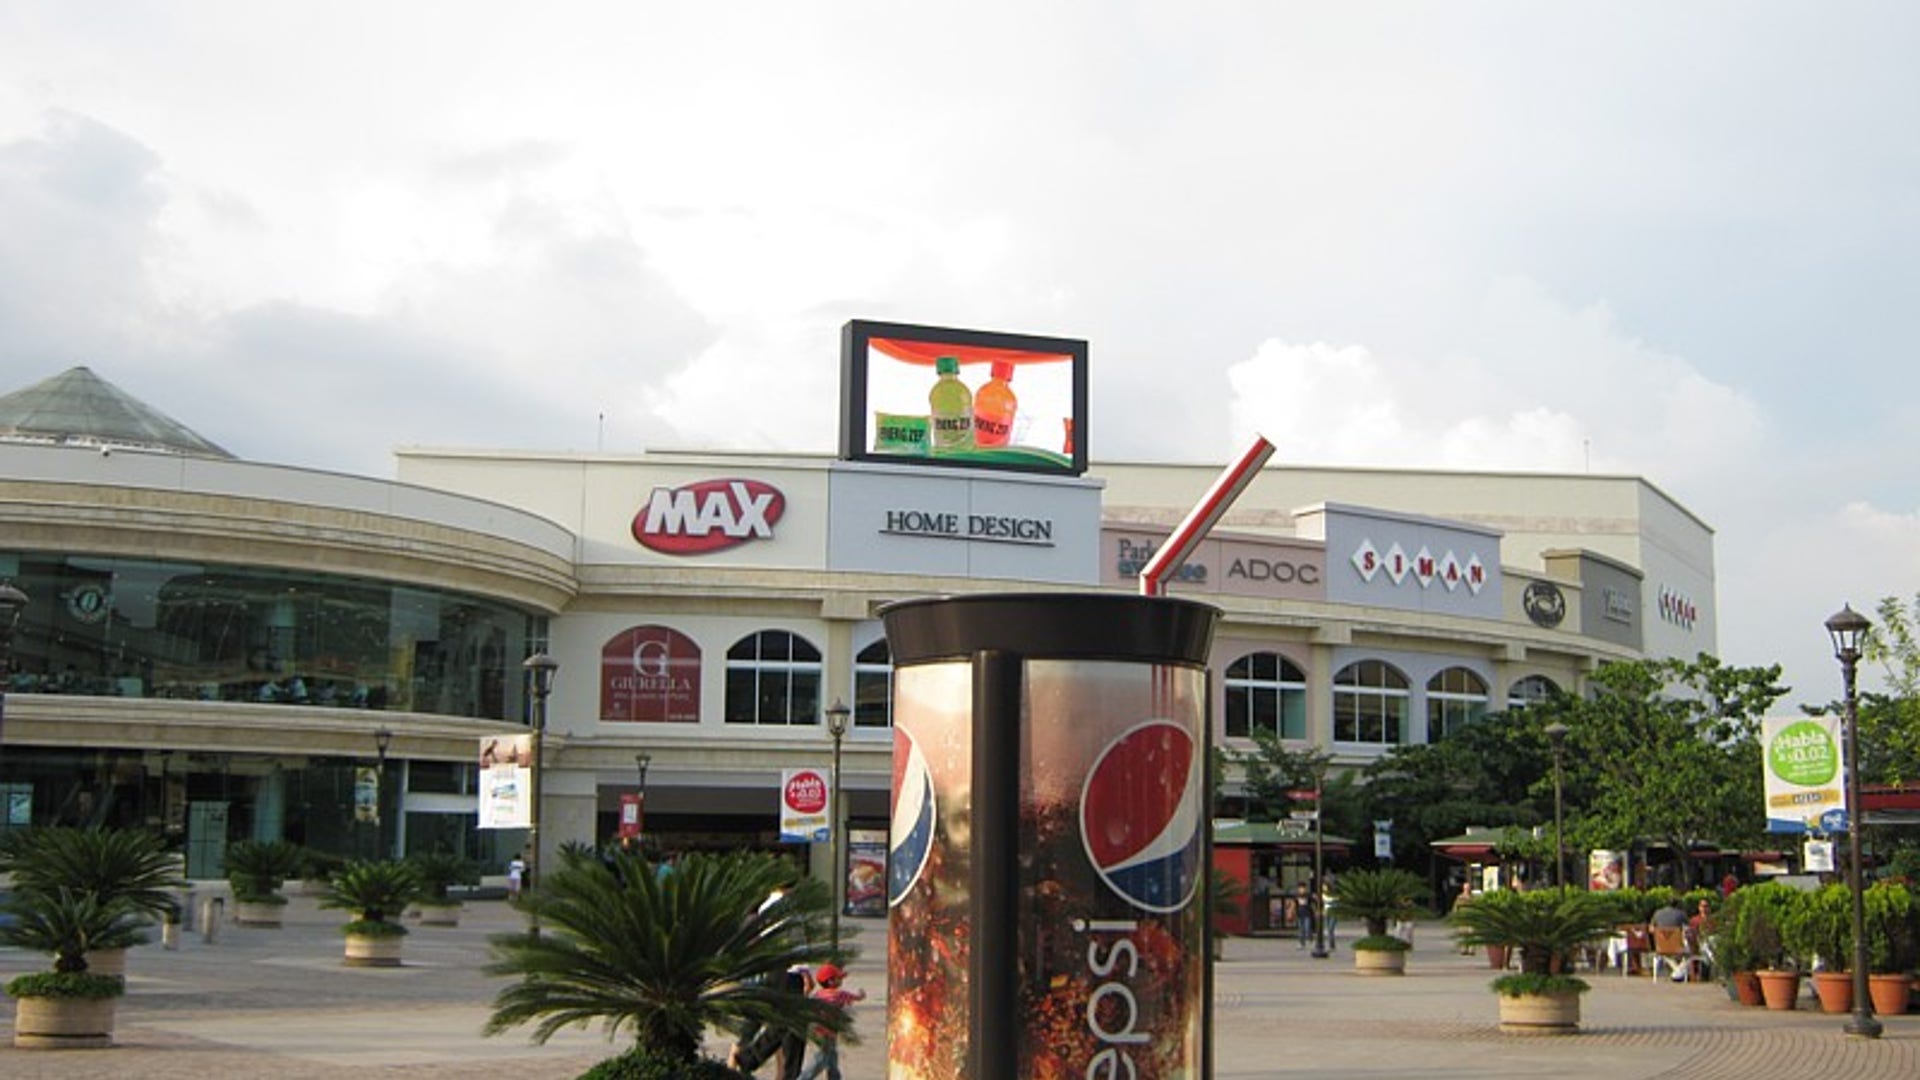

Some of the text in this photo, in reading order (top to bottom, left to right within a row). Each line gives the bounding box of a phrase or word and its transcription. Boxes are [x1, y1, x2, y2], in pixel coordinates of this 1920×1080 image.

[644, 481, 774, 538] MAX
[887, 511, 1052, 539] HOME DESIGN
[1228, 558, 1319, 584] ADOC
[1362, 549, 1484, 585] SIMAN
